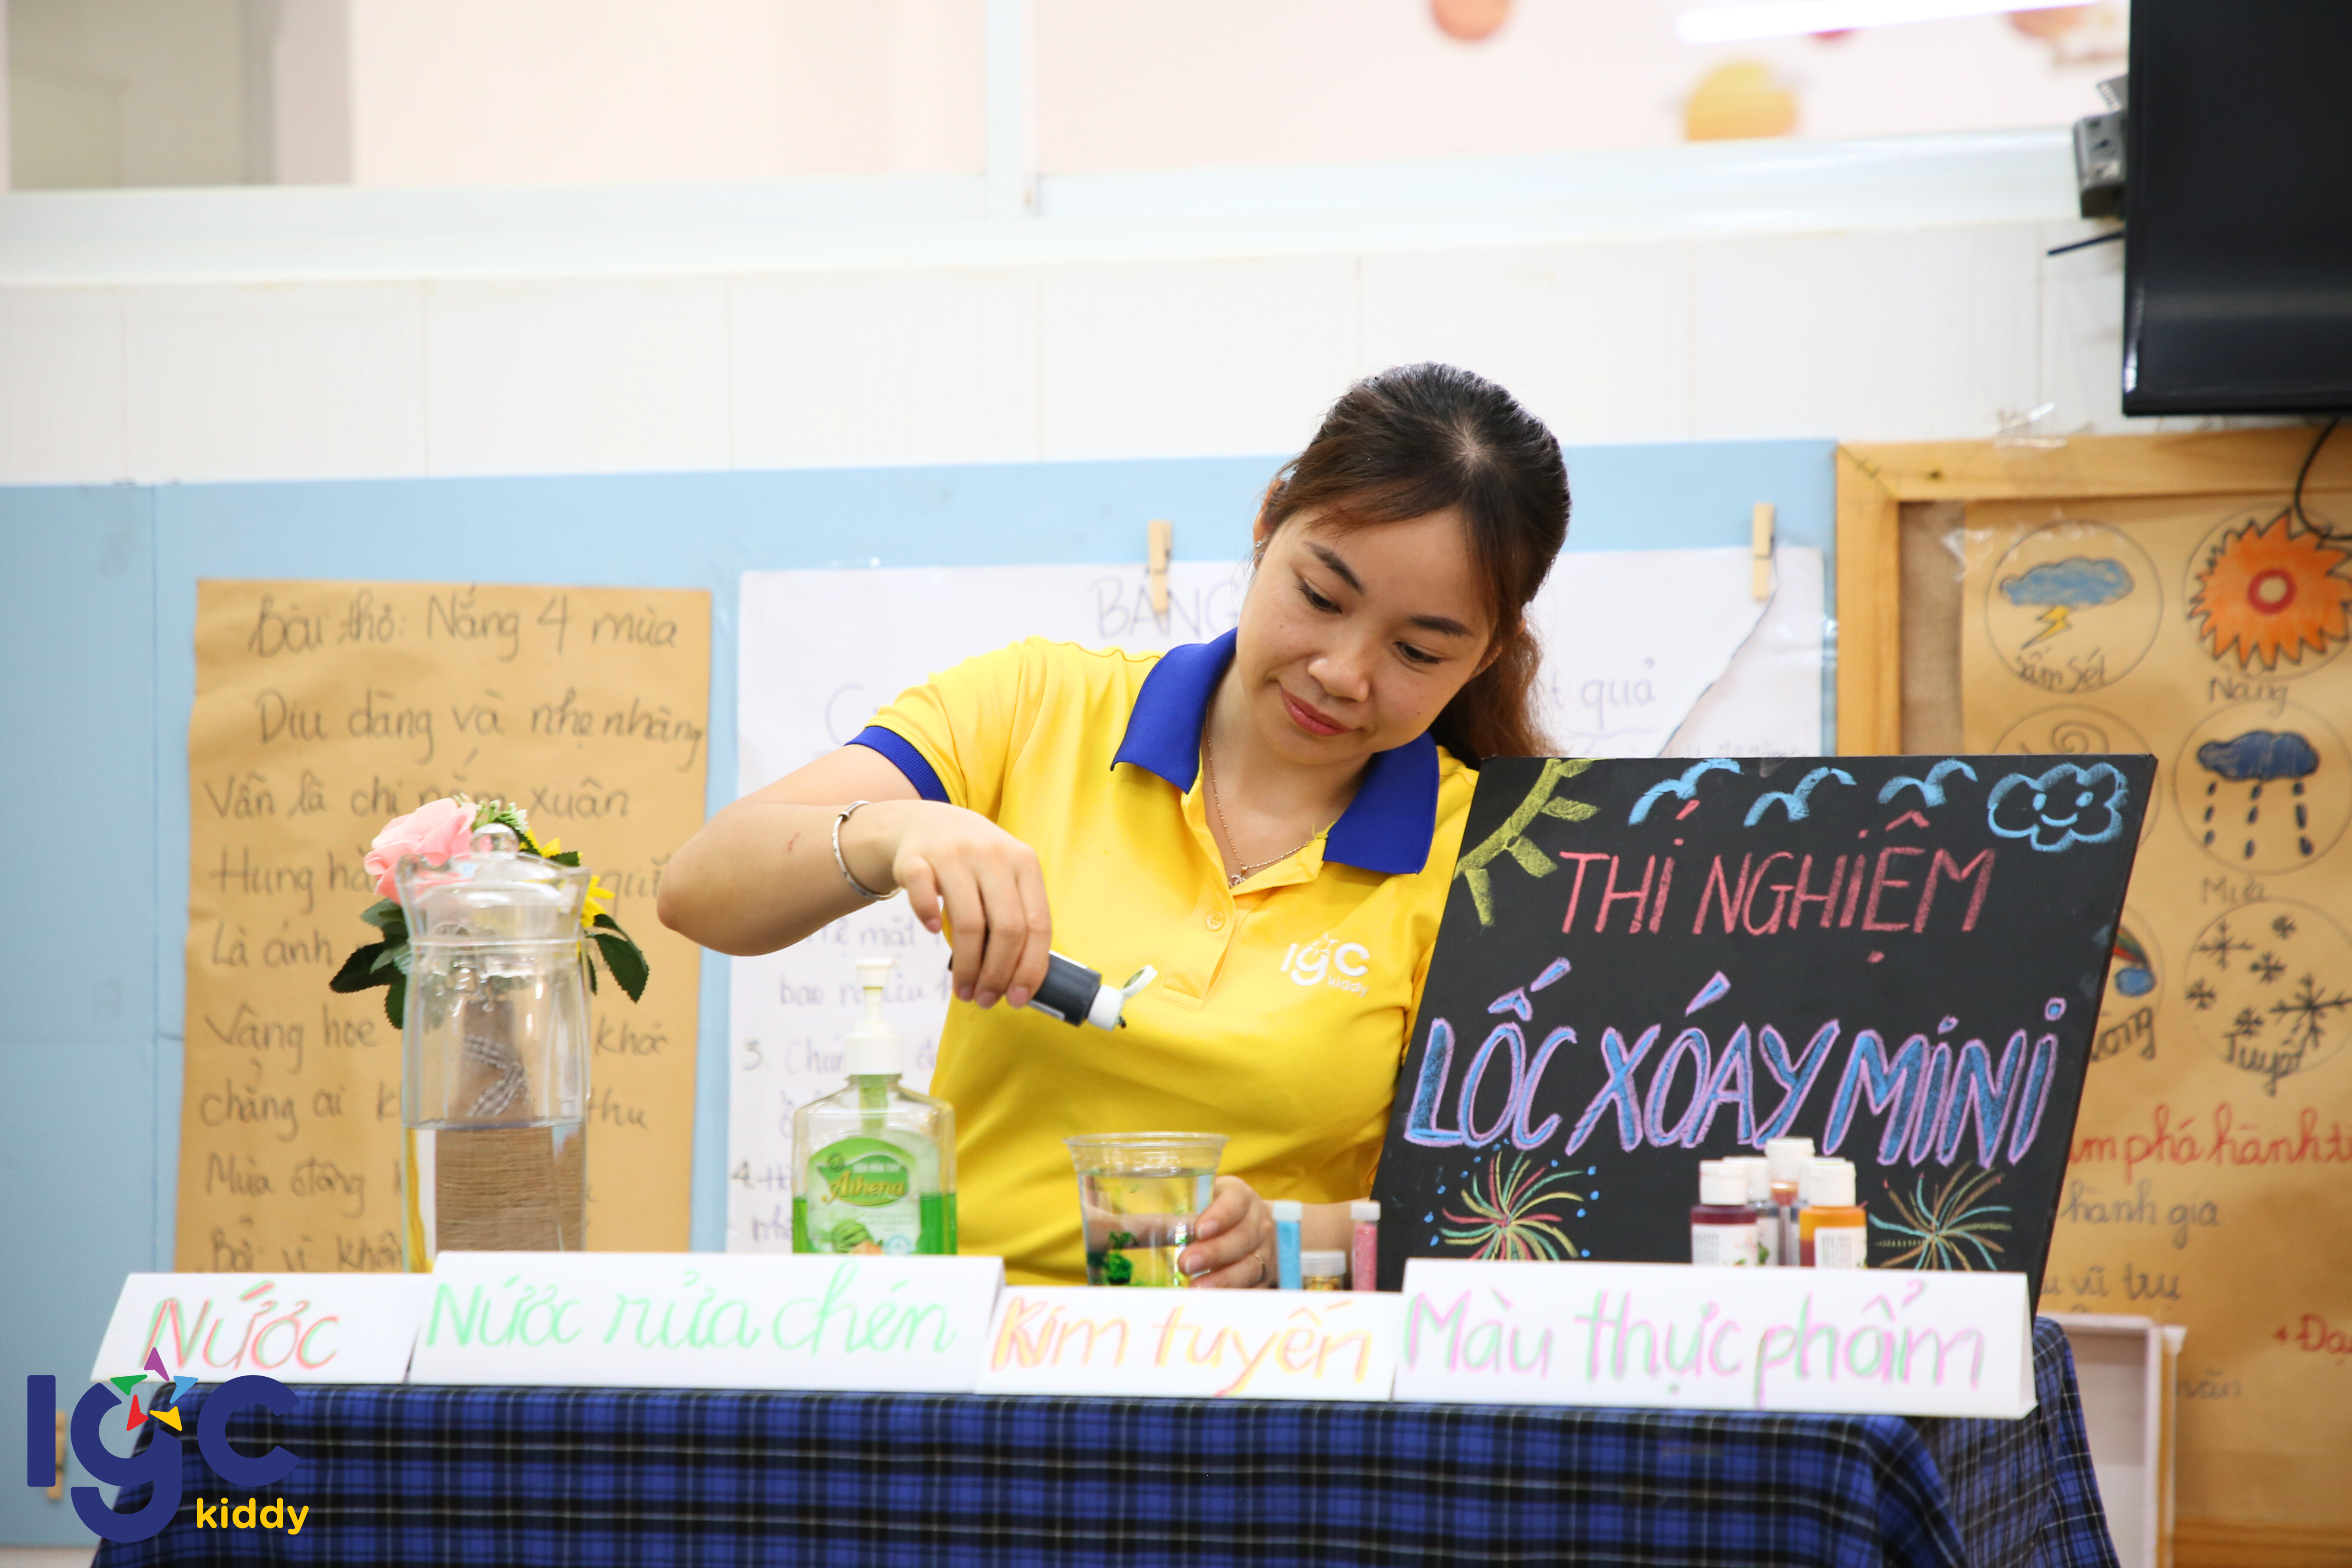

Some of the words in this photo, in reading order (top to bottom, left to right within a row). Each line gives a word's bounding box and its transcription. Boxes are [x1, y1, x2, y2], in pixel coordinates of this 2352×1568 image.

[427, 583, 520, 662] Nắng
[536, 593, 570, 655] 4
[591, 605, 678, 650] mùa
[1582, 657, 1657, 731] quả
[254, 687, 328, 756] Dịu
[347, 689, 435, 766] dàng
[450, 688, 508, 737] và
[531, 687, 593, 750] nhẹ
[603, 695, 704, 774] nhàng
[204, 771, 276, 820] Vẫn
[529, 776, 630, 820] xuân
[212, 919, 250, 967] Là
[263, 919, 334, 968] ánh
[779, 971, 824, 1006] bao
[1328, 974, 1370, 998] kiddy
[1404, 957, 1577, 1151] LỐC
[1566, 971, 1840, 1155] XÓAY
[312, 1082, 347, 1118] ai
[2125, 1102, 2206, 1185] phá
[2206, 1101, 2325, 1167] hành
[205, 1151, 275, 1197] Mùa
[290, 1156, 366, 1220] đông
[821, 1171, 907, 1205] Athena
[773, 1259, 958, 1356] chén
[2069, 1264, 2111, 1297] vũ
[1152, 1299, 1373, 1397] tuyến
[1401, 1287, 1554, 1375] Màu
[1574, 1289, 1743, 1396] thực
[1754, 1278, 1986, 1411] phẩm
